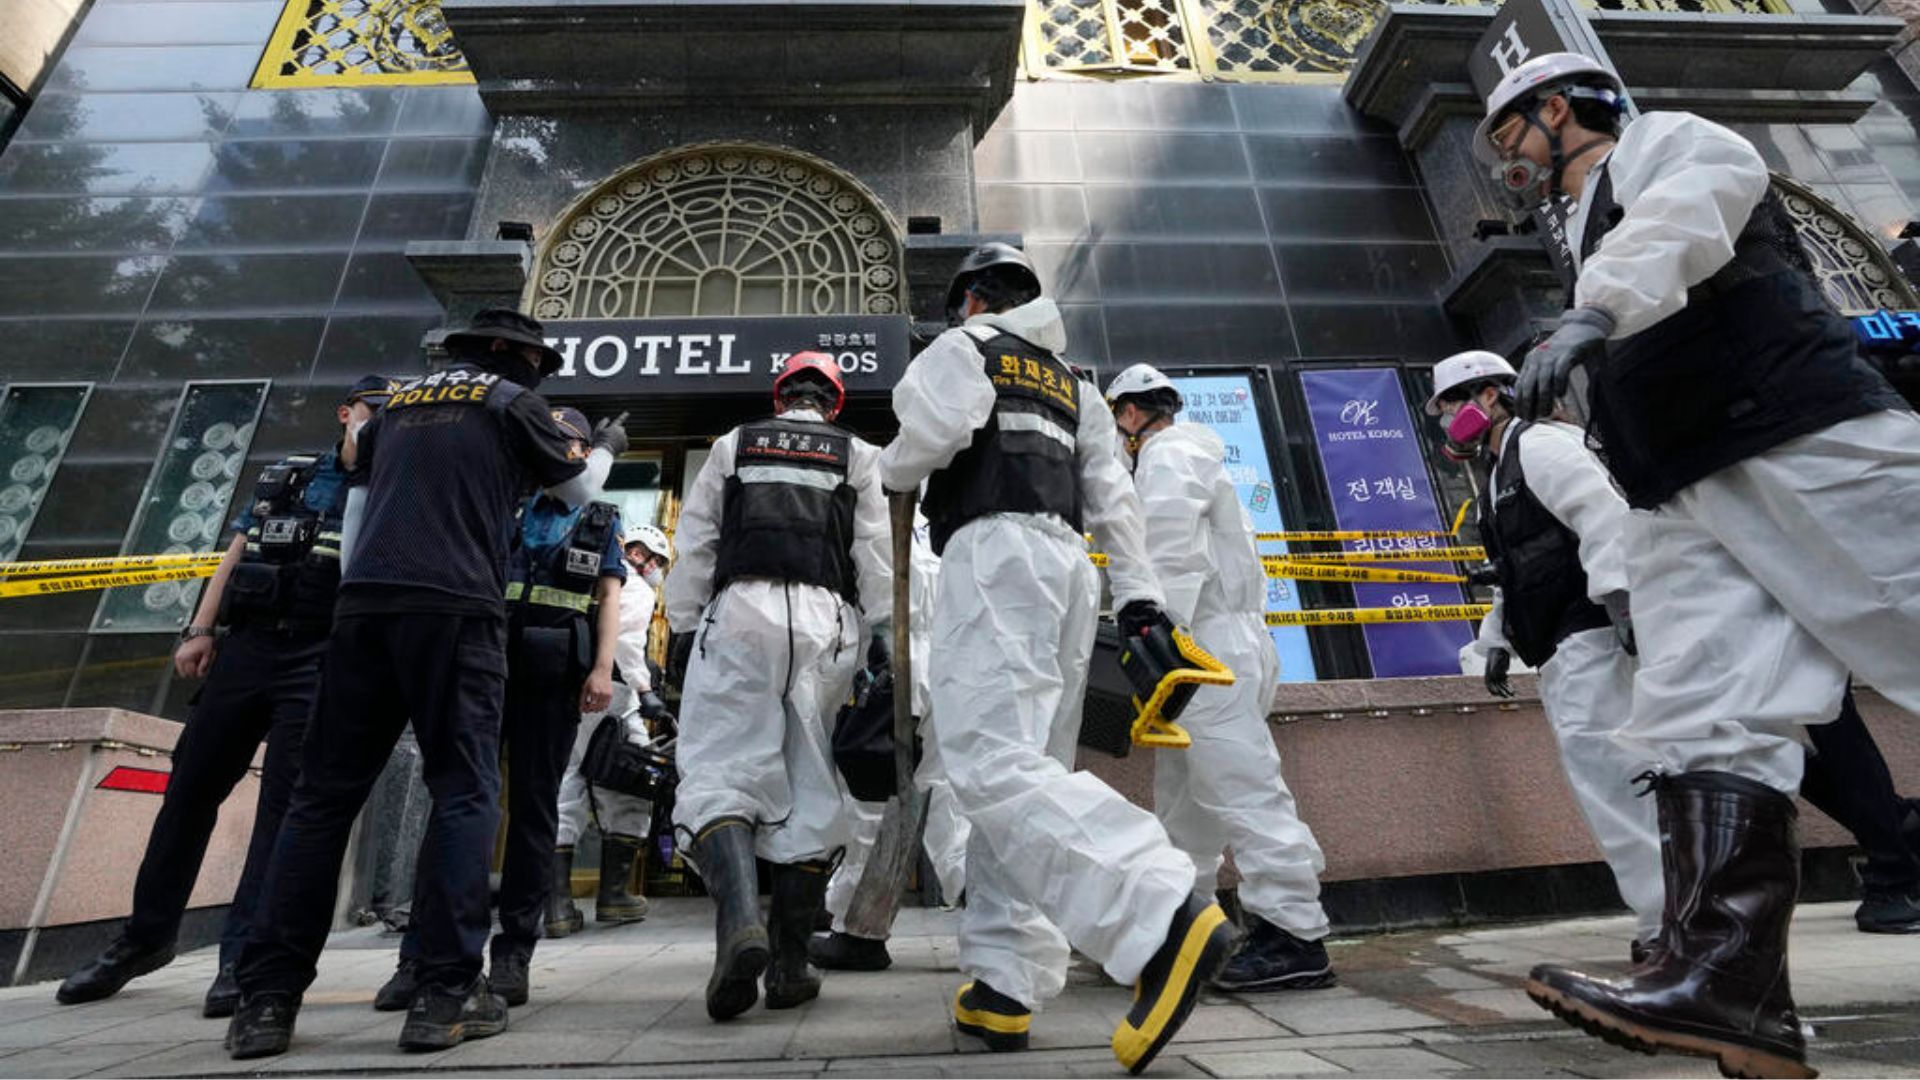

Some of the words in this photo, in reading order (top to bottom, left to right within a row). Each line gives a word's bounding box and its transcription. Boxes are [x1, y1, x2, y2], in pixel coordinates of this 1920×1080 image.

[543, 334, 751, 377] HOTEL
[386, 384, 488, 409] POLICE
[1328, 432, 1367, 441] HOTEL
[1346, 478, 1371, 502] 전
[1374, 476, 1417, 501] 객실
